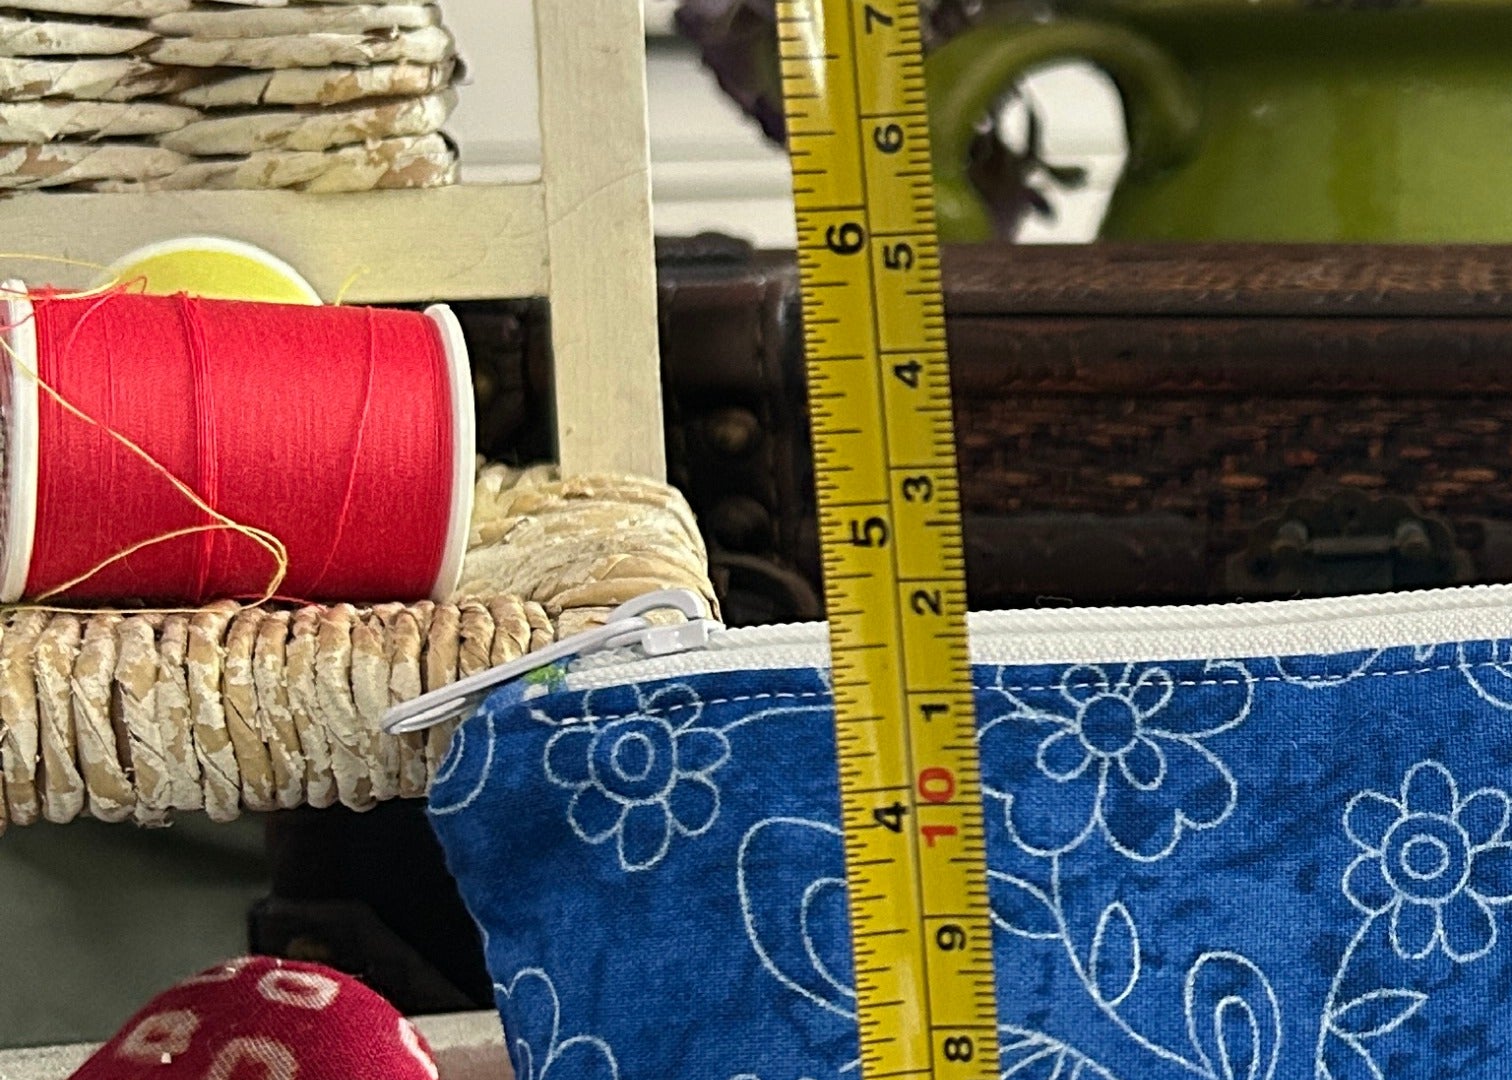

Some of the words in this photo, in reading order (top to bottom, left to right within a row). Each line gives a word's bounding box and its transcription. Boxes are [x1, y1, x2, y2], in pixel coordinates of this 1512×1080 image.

[864, 4, 894, 35] 7
[873, 123, 904, 155] 6
[826, 222, 867, 257] 6
[884, 243, 913, 272] 5
[893, 360, 923, 390] 4
[902, 475, 933, 503] 3
[852, 516, 890, 549] 5
[912, 589, 943, 617] 2
[920, 703, 950, 723] 1
[873, 801, 907, 834] 4
[936, 924, 967, 952] 9
[943, 1035, 974, 1063] 8
